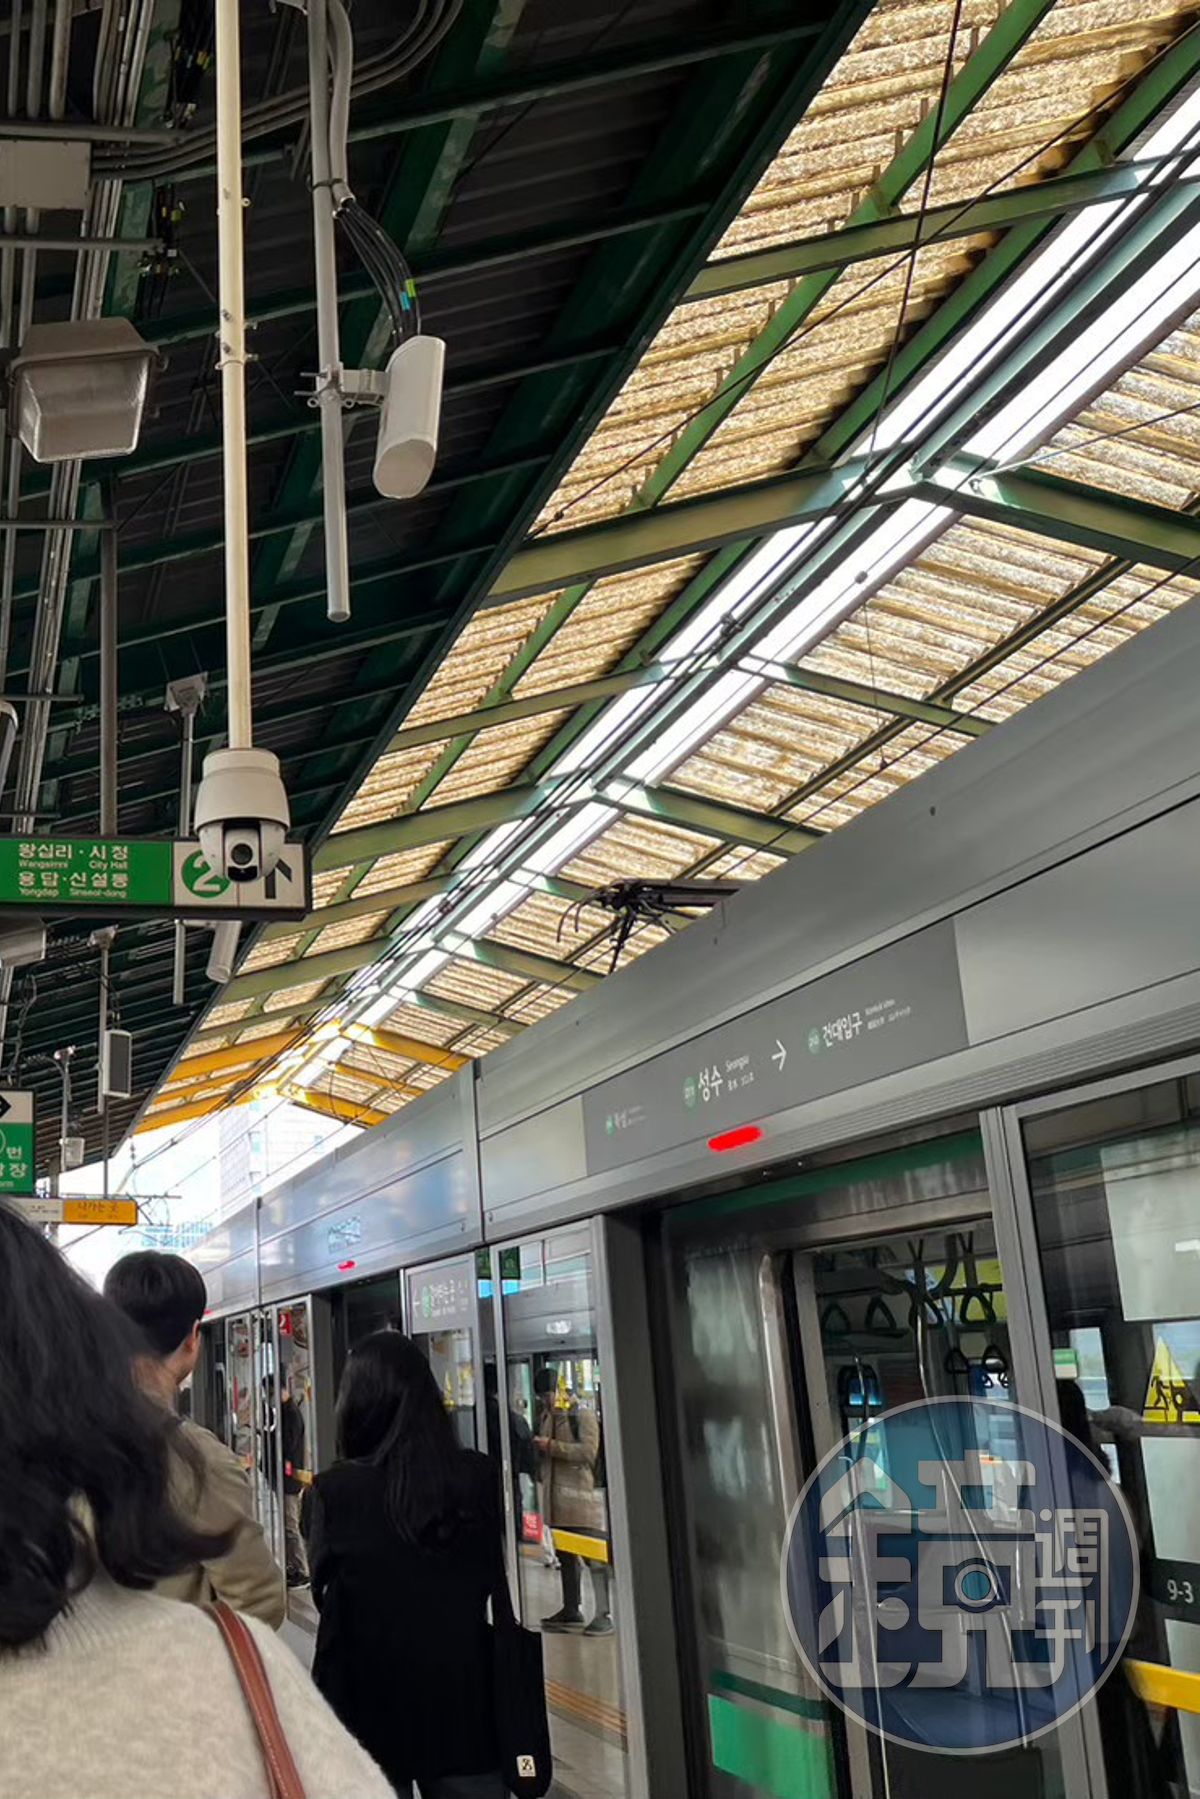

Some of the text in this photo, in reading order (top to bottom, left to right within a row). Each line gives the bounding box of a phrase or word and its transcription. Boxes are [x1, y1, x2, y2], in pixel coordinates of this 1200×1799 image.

[18, 843, 72, 860] 왕십리
[821, 1011, 863, 1048] 건대입구
[697, 1064, 724, 1103] 성수
[1166, 1578, 1195, 1604] 9-3
